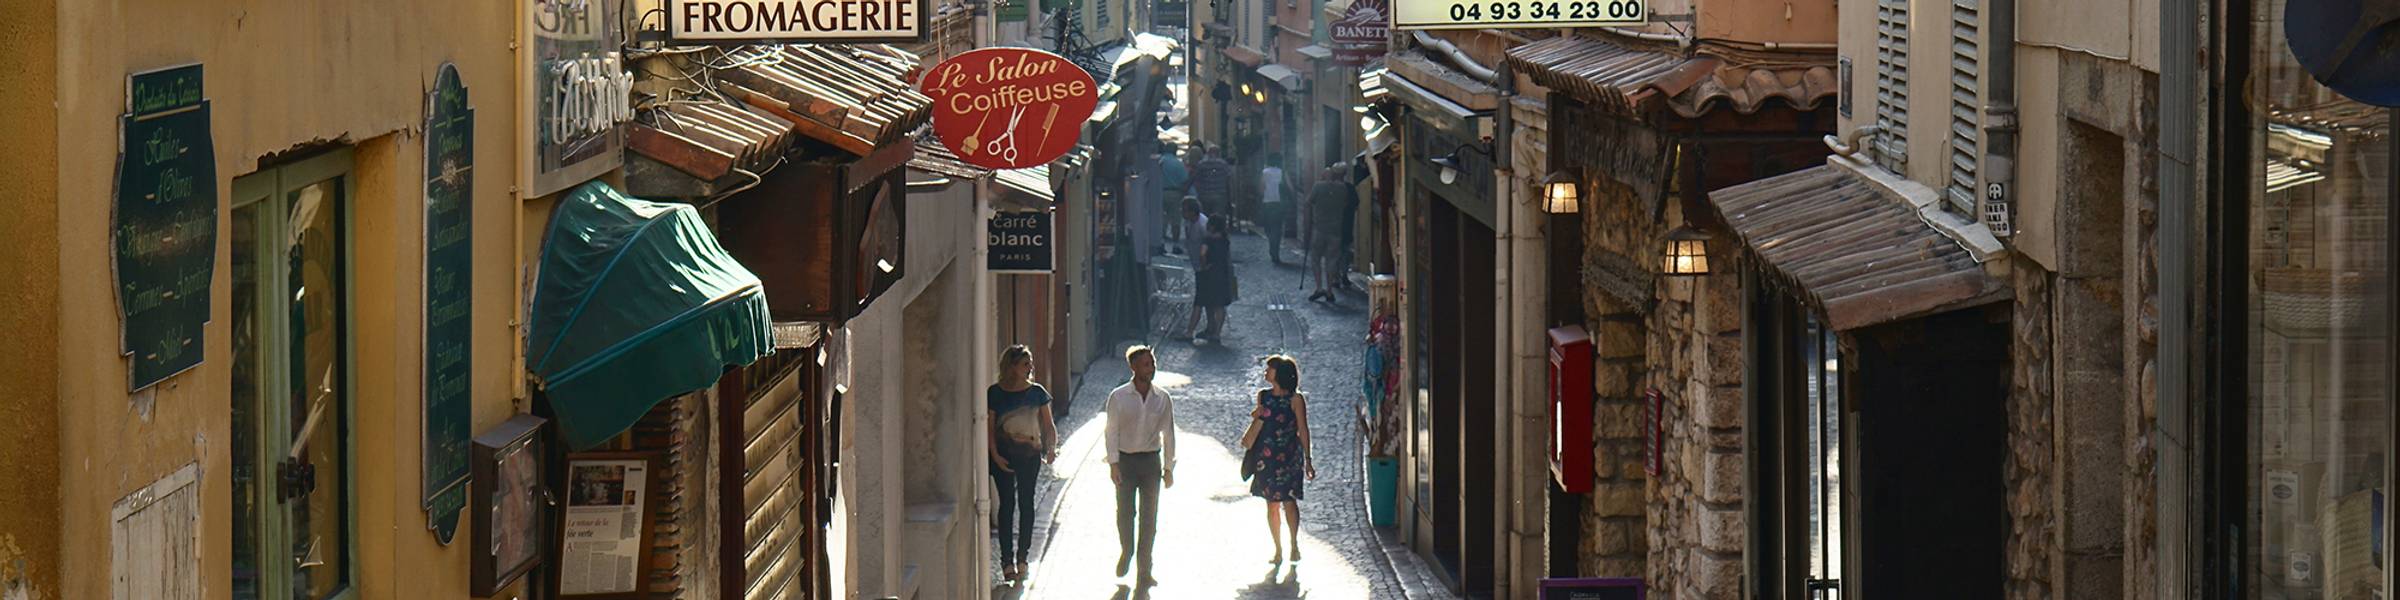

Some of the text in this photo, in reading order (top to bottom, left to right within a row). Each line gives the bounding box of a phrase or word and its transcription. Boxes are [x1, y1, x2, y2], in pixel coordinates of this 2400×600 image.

[683, 1, 912, 32] FROMAGERIE
[1450, 1, 1640, 21] 04 93 34 23 00
[928, 52, 1061, 96] Le Salon
[951, 79, 1087, 115] Coiffeuse
[993, 214, 1037, 228] carré
[988, 231, 1043, 247] blanc
[1000, 253, 1031, 261] PARIS
